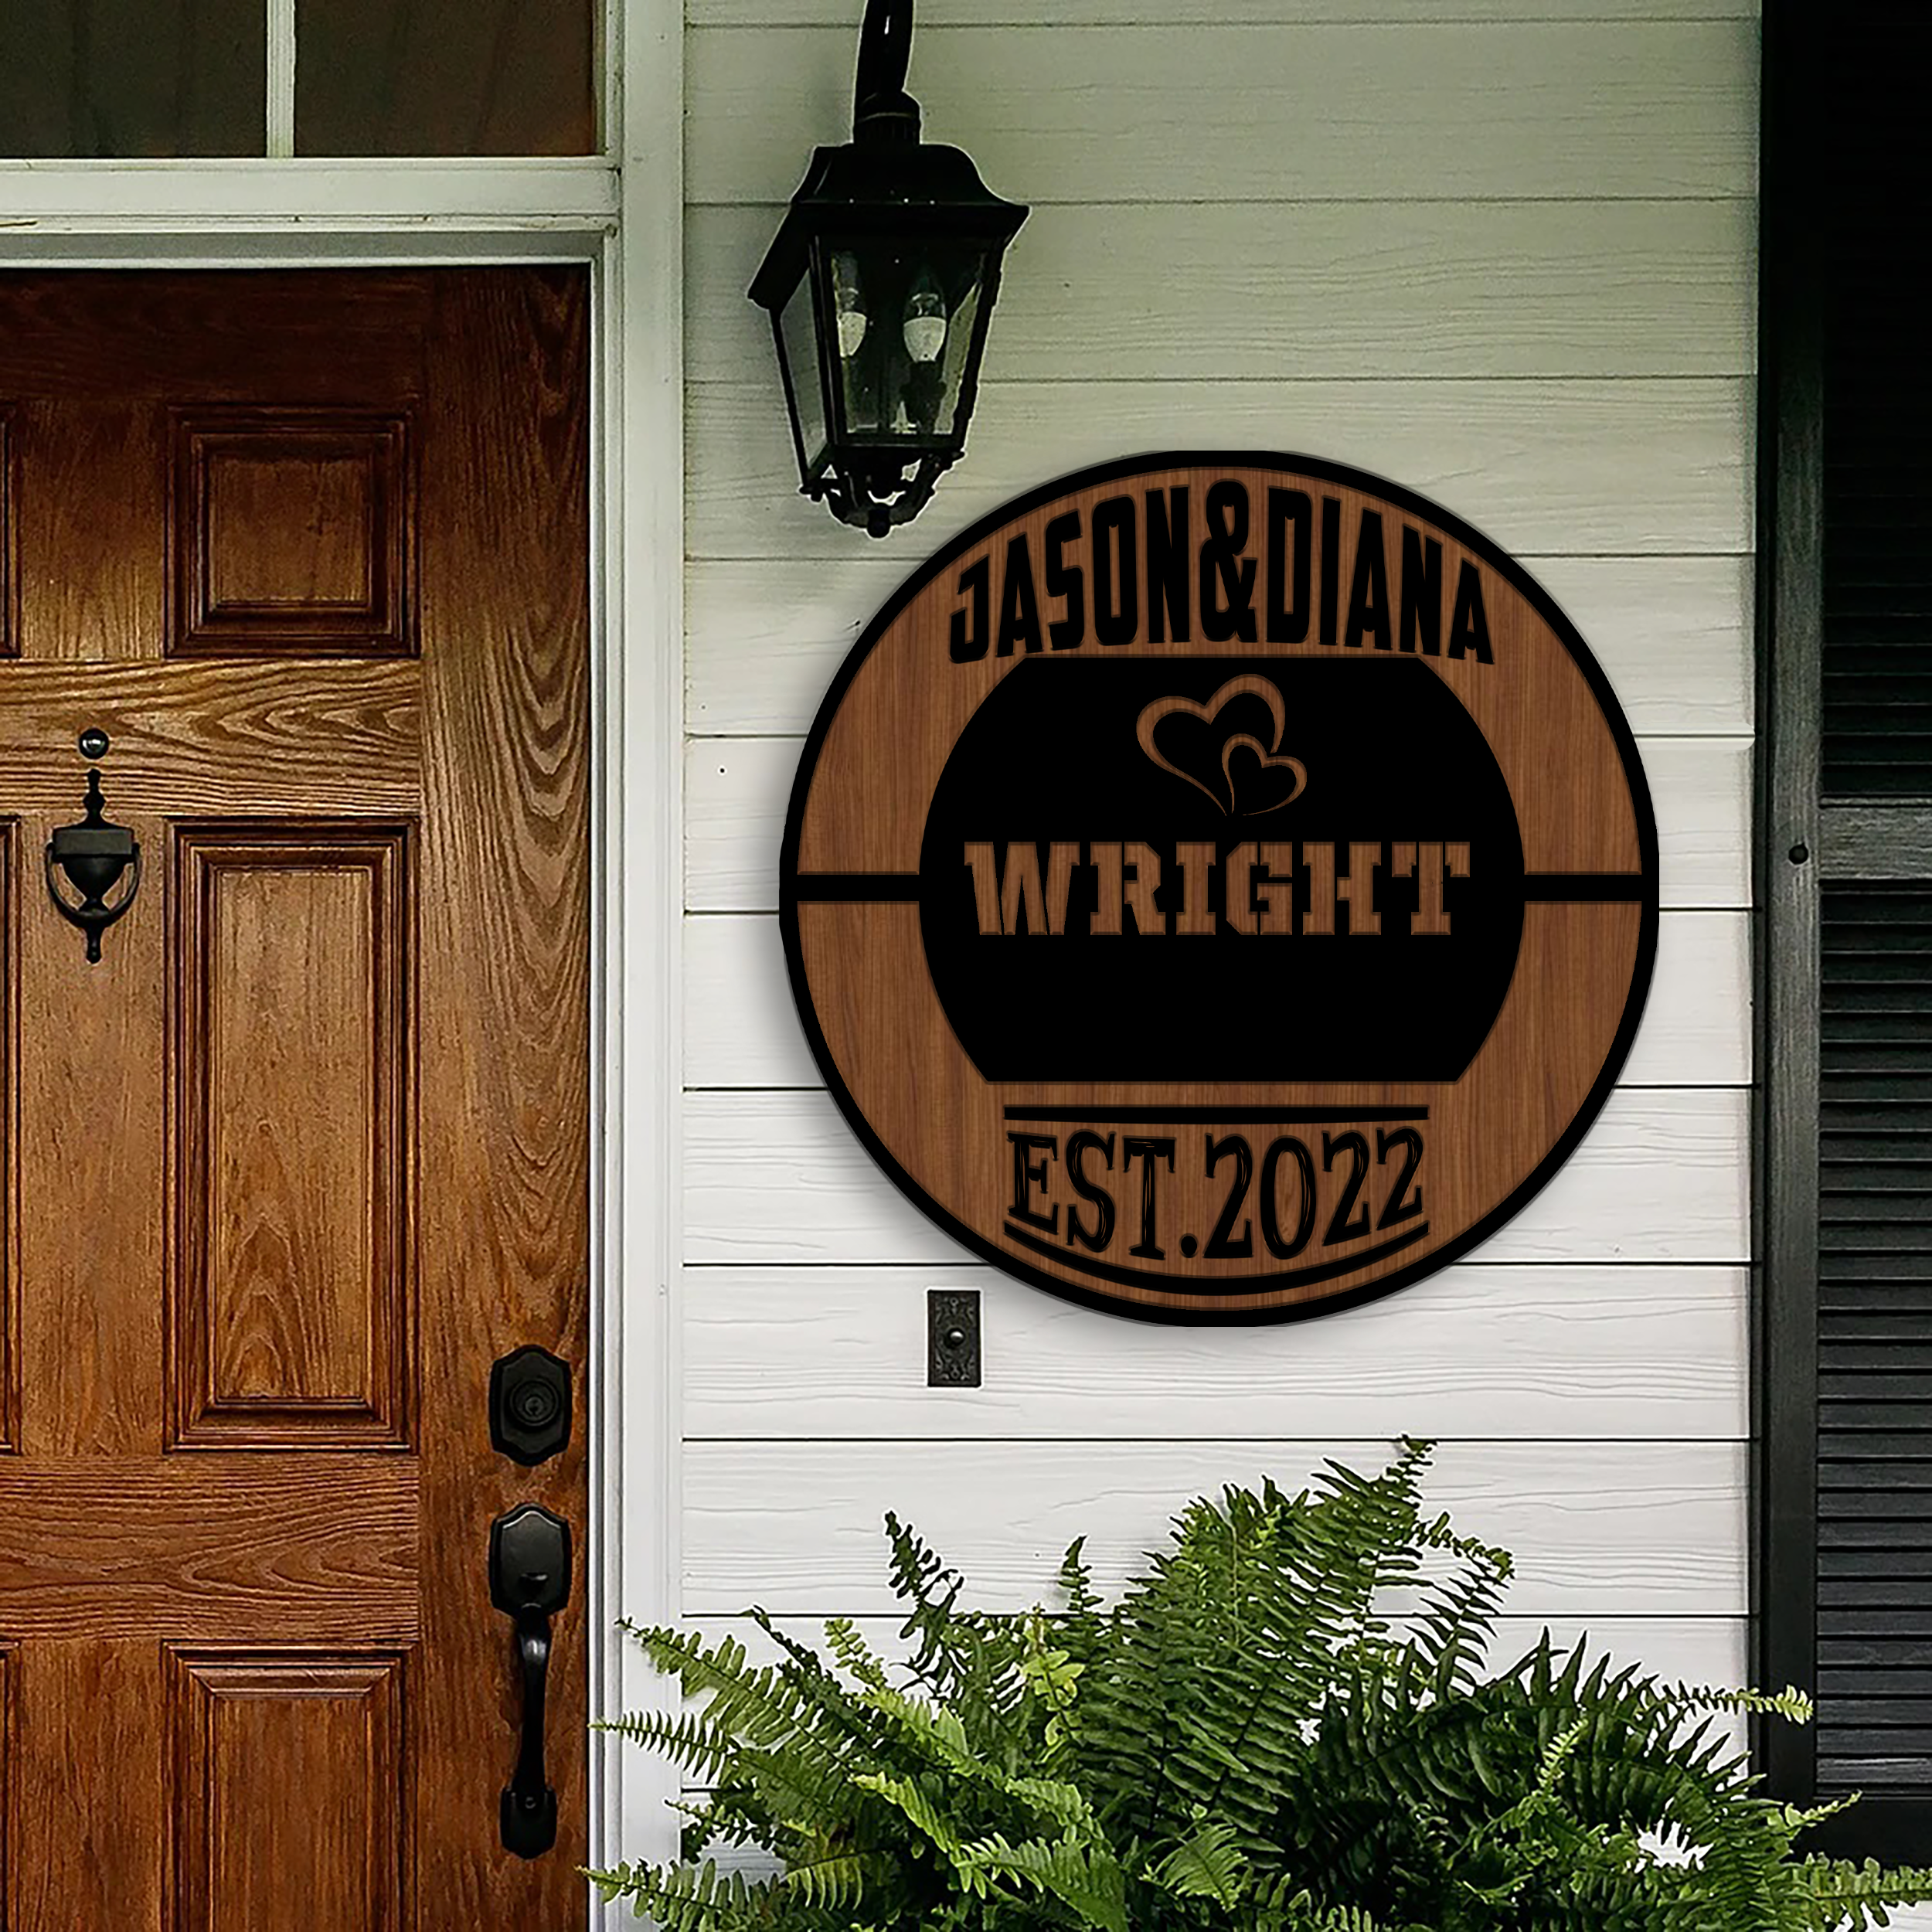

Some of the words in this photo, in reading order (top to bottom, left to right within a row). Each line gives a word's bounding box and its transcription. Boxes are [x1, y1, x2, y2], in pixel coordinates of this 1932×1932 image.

[949, 479, 1495, 664] JASON&DIANA
[964, 841, 1471, 936] WRIGHT
[1007, 1127, 1424, 1260] EST.2022
